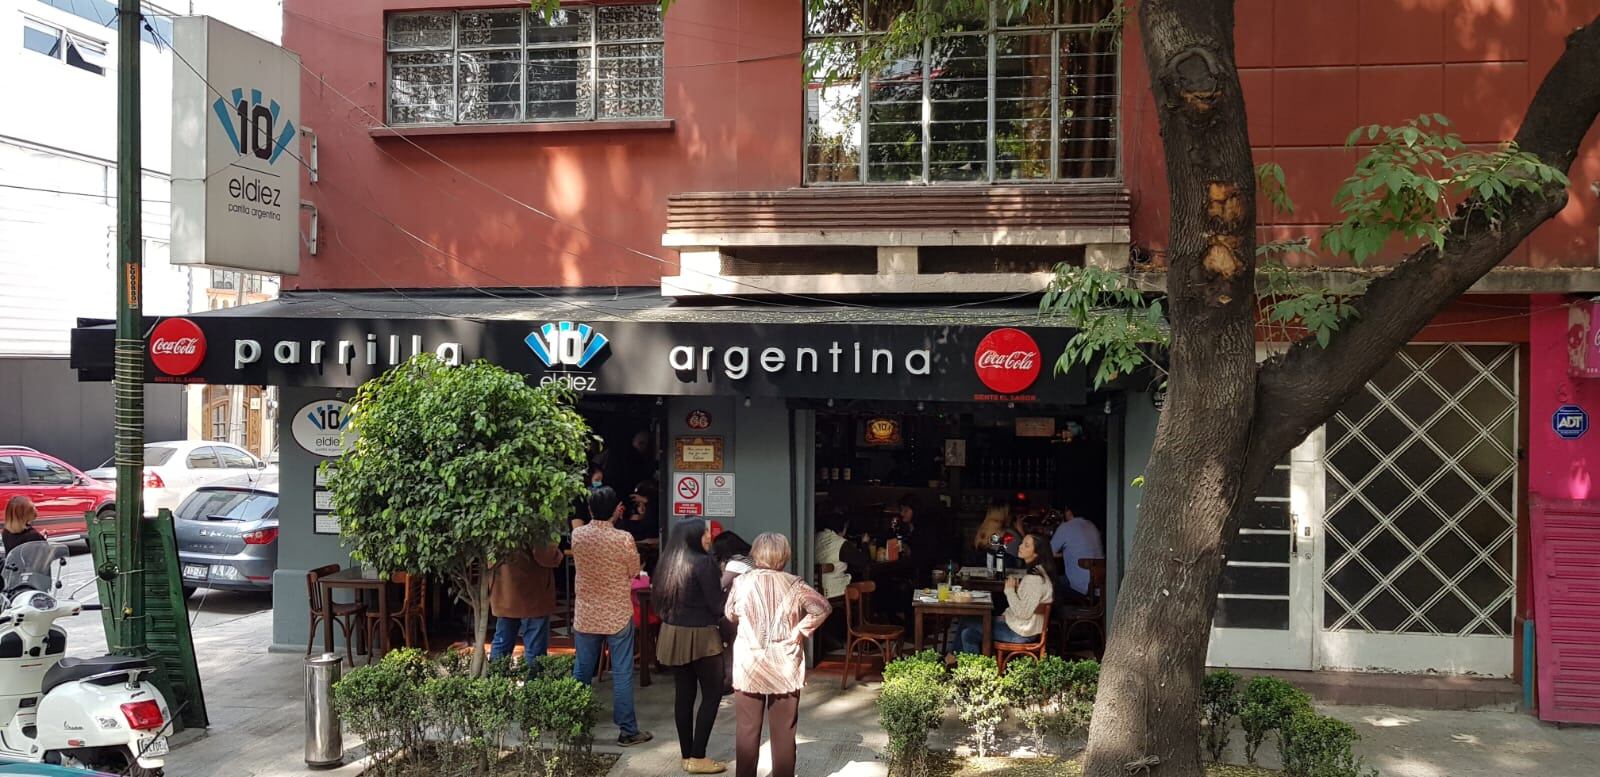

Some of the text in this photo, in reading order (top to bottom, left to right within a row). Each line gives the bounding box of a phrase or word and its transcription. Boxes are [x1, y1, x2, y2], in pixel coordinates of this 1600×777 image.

[237, 99, 273, 160] 10
[228, 175, 281, 207] eldiez
[228, 203, 281, 221] parrilla argentina
[152, 337, 199, 355] Coca-Cola
[234, 333, 463, 369] parrilla
[543, 330, 583, 365] 10
[668, 341, 931, 380] argentina
[978, 349, 1037, 370] Coca-Cola
[319, 410, 340, 429] 10
[1558, 415, 1583, 428] ADT
[315, 436, 342, 447] eldie
